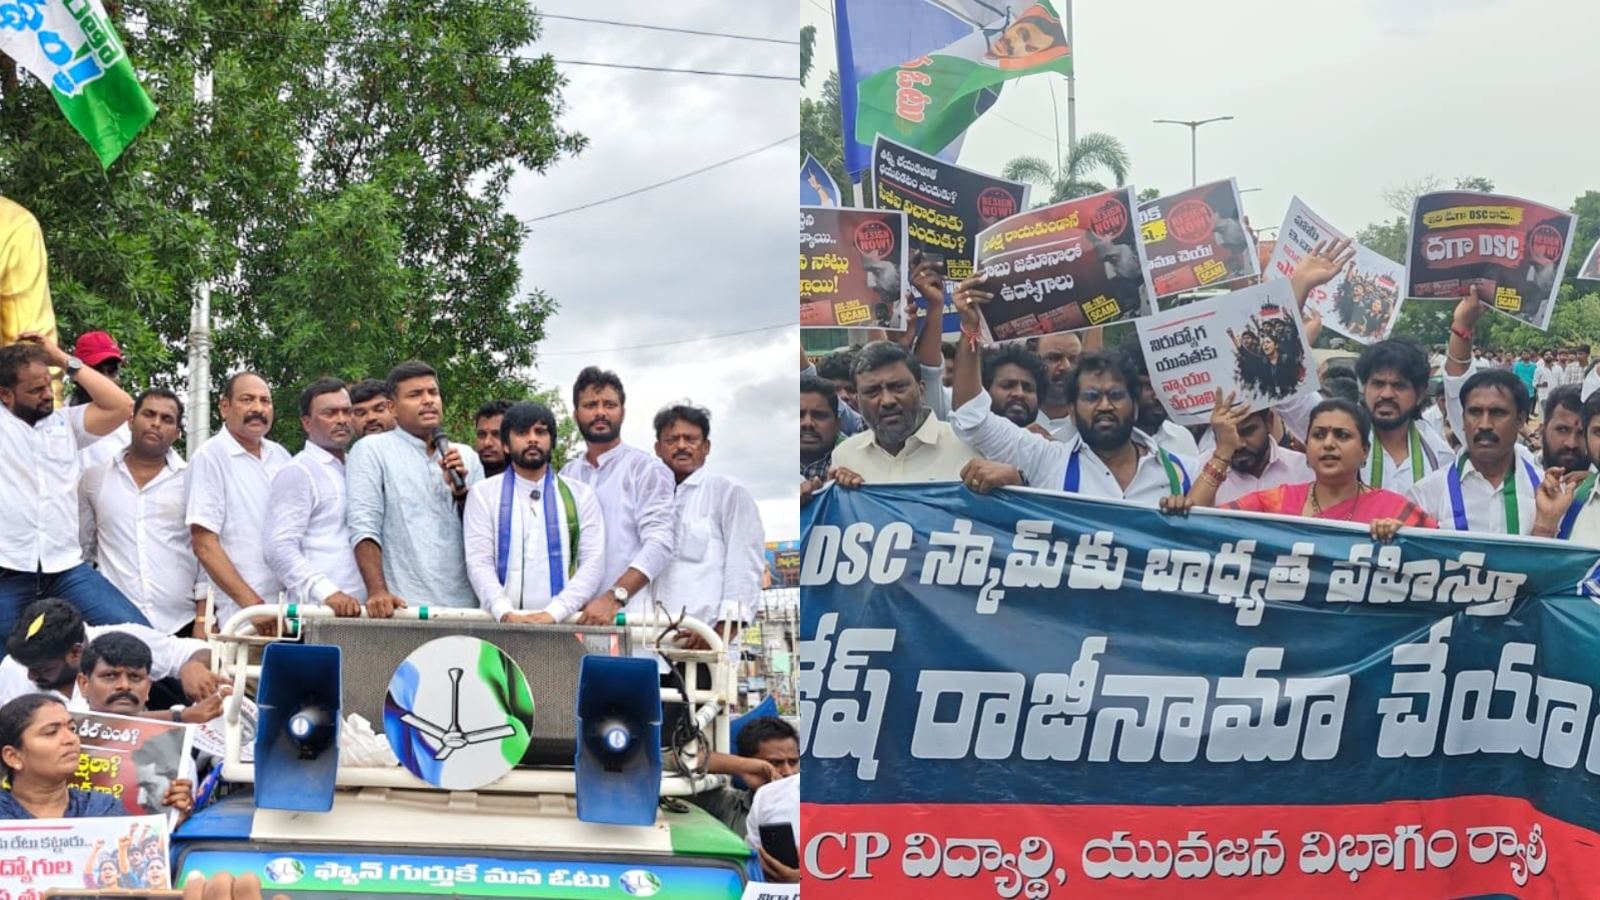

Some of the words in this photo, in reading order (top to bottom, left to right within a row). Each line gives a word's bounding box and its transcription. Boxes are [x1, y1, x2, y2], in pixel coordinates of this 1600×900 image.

[1469, 210, 1488, 220] DSC
[908, 222, 967, 253] ఎందుకు?
[1426, 236, 1474, 261] దగా
[1478, 234, 1519, 260] DSC
[1000, 274, 1074, 302] ఉద్యోగాలు
[1149, 326, 1208, 353] నిరుద్యోగ
[1155, 345, 1218, 372] యువతకు
[1161, 371, 1211, 395] న్యాయం
[1168, 390, 1217, 410] చేయాలి
[800, 521, 914, 586] DSC
[1141, 539, 1316, 627] బాధ్యత
[911, 635, 1351, 764] రాజీనామా
[1377, 616, 1600, 776] చేయా
[101, 726, 140, 745] ఎంత?
[1082, 829, 1286, 880] యువజన
[1299, 824, 1458, 883] విభాగం
[1466, 823, 1547, 886] ర్యాలీ
[314, 861, 383, 886] ఫ్యాన్
[389, 862, 478, 887] గుర్తుకే
[484, 868, 542, 885] మన
[548, 870, 611, 888] ఓటు
